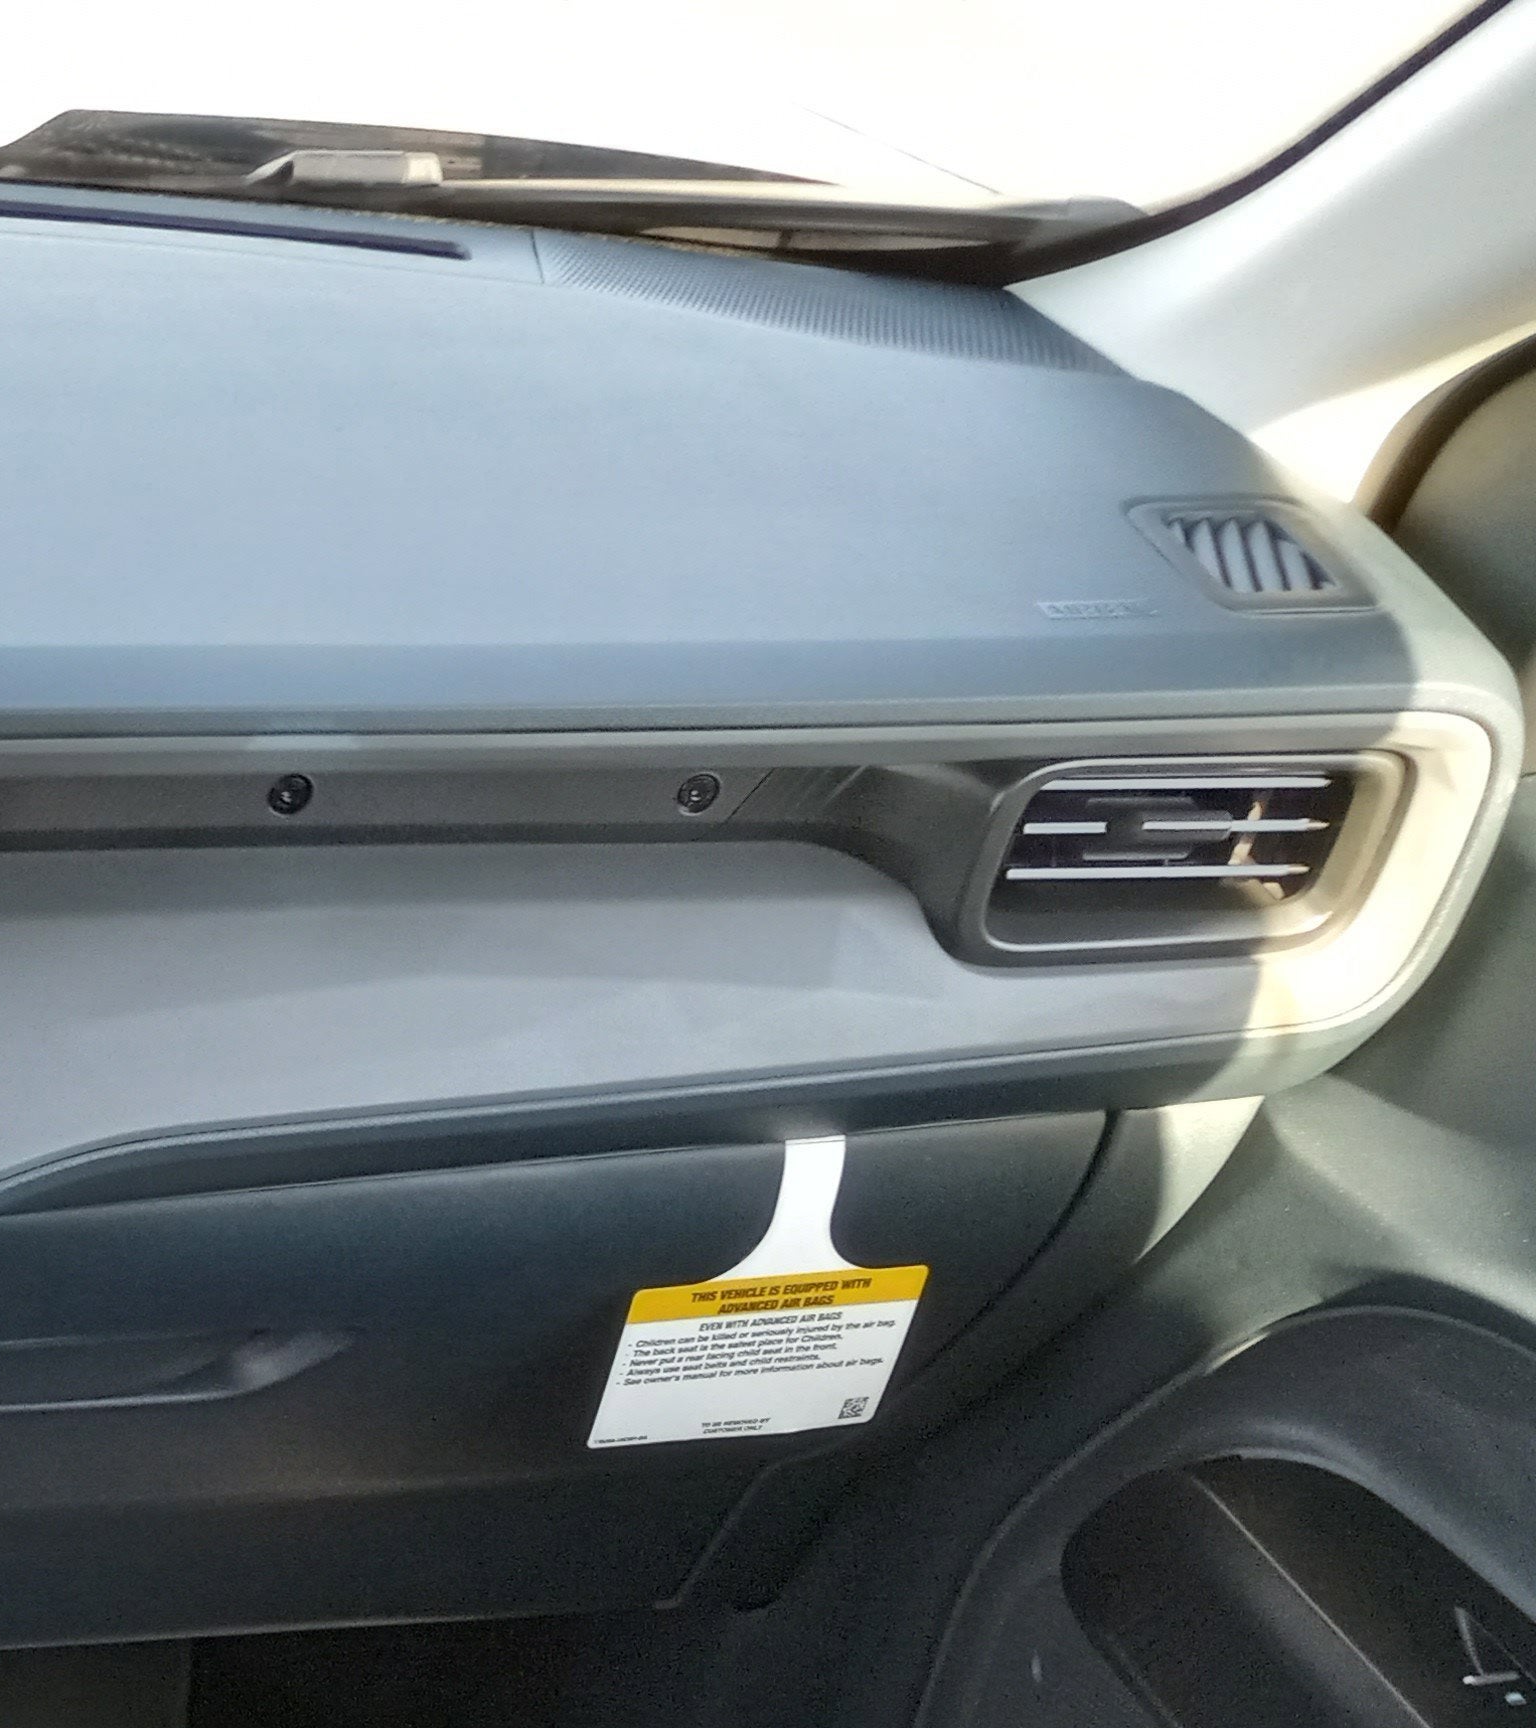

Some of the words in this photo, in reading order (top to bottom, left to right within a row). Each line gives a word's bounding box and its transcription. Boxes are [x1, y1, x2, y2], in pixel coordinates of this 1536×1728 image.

[692, 1291, 717, 1303] THIS
[783, 1281, 839, 1294] EQUIPPED
[841, 1278, 872, 1289] WITH
